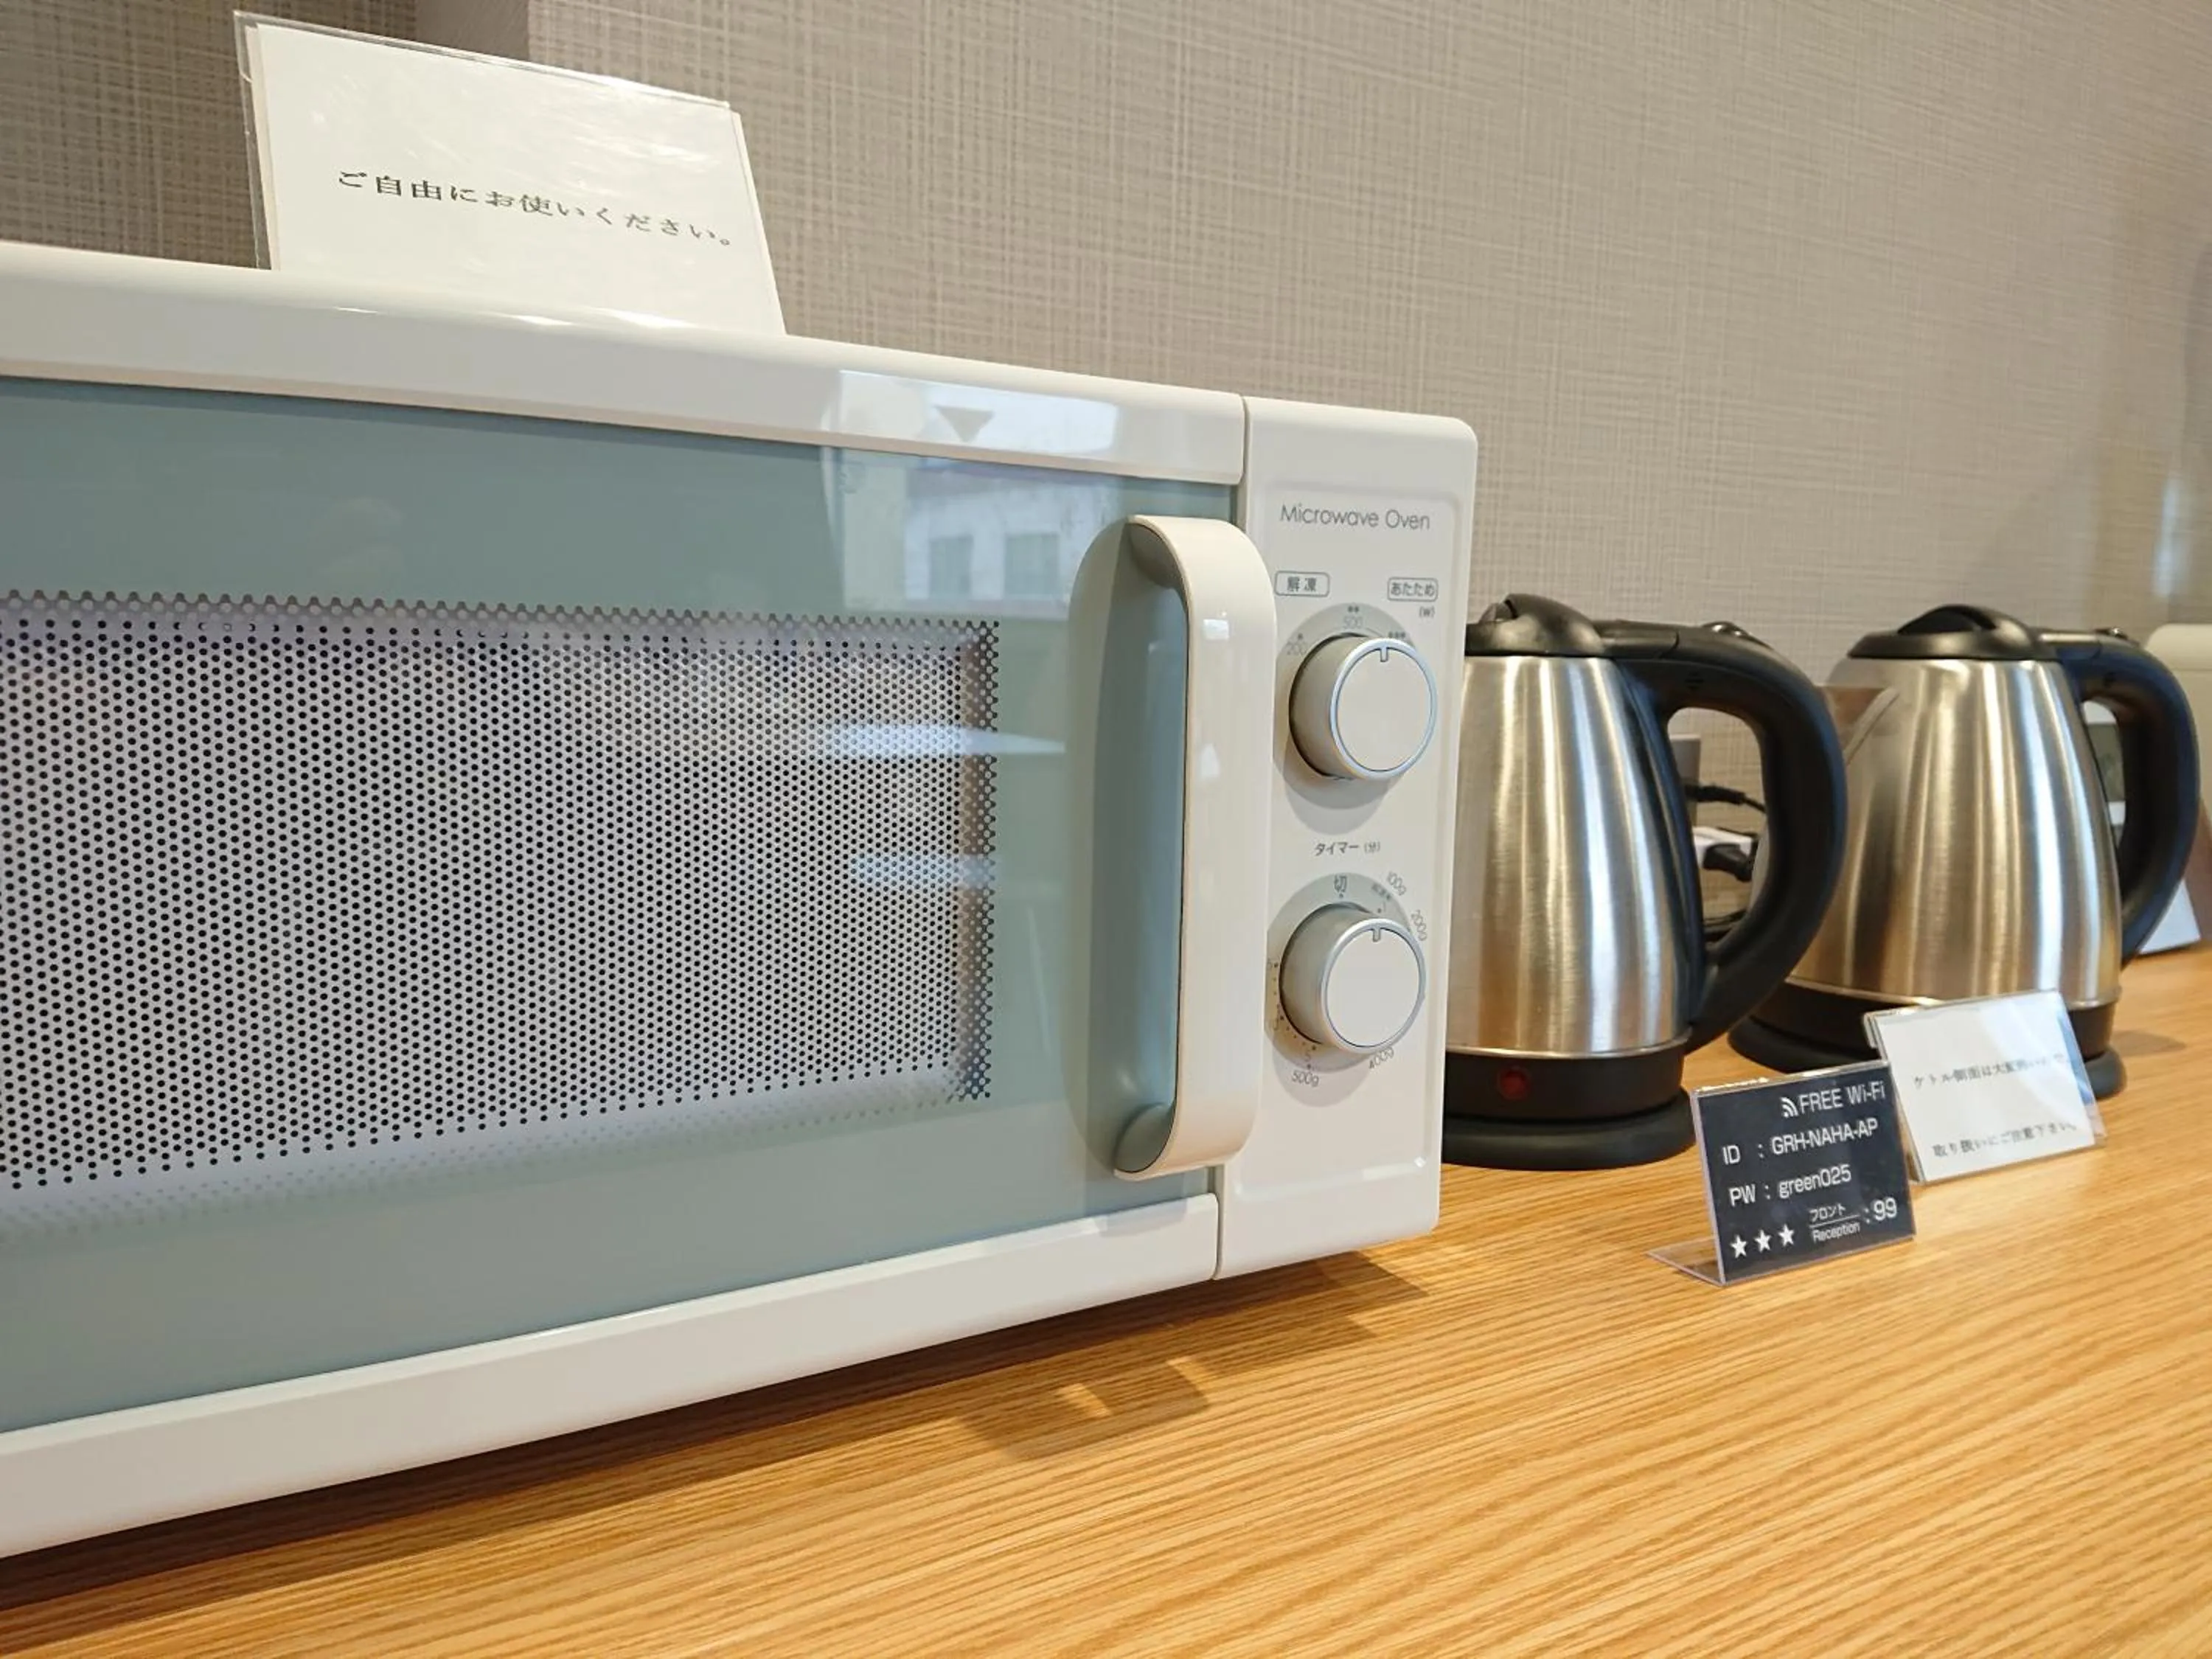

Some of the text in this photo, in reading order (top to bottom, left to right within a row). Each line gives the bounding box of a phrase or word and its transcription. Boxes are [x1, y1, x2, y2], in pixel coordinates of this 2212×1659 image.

[338, 170, 730, 246] ご自由にお使いください。
[1279, 503, 1430, 529] Microwave Oven
[1391, 582, 1435, 597] あたため
[1314, 841, 1360, 856] タイマー
[1798, 1081, 1886, 1115] FREE Wi-Fi
[1722, 1145, 1741, 1165] ID
[1772, 1117, 1879, 1155] GRH-NAHA-AP
[1728, 1184, 1756, 1207] PW
[1778, 1164, 1852, 1199] green025
[1809, 1203, 1846, 1222] フロント
[1812, 1221, 1861, 1243] Reception
